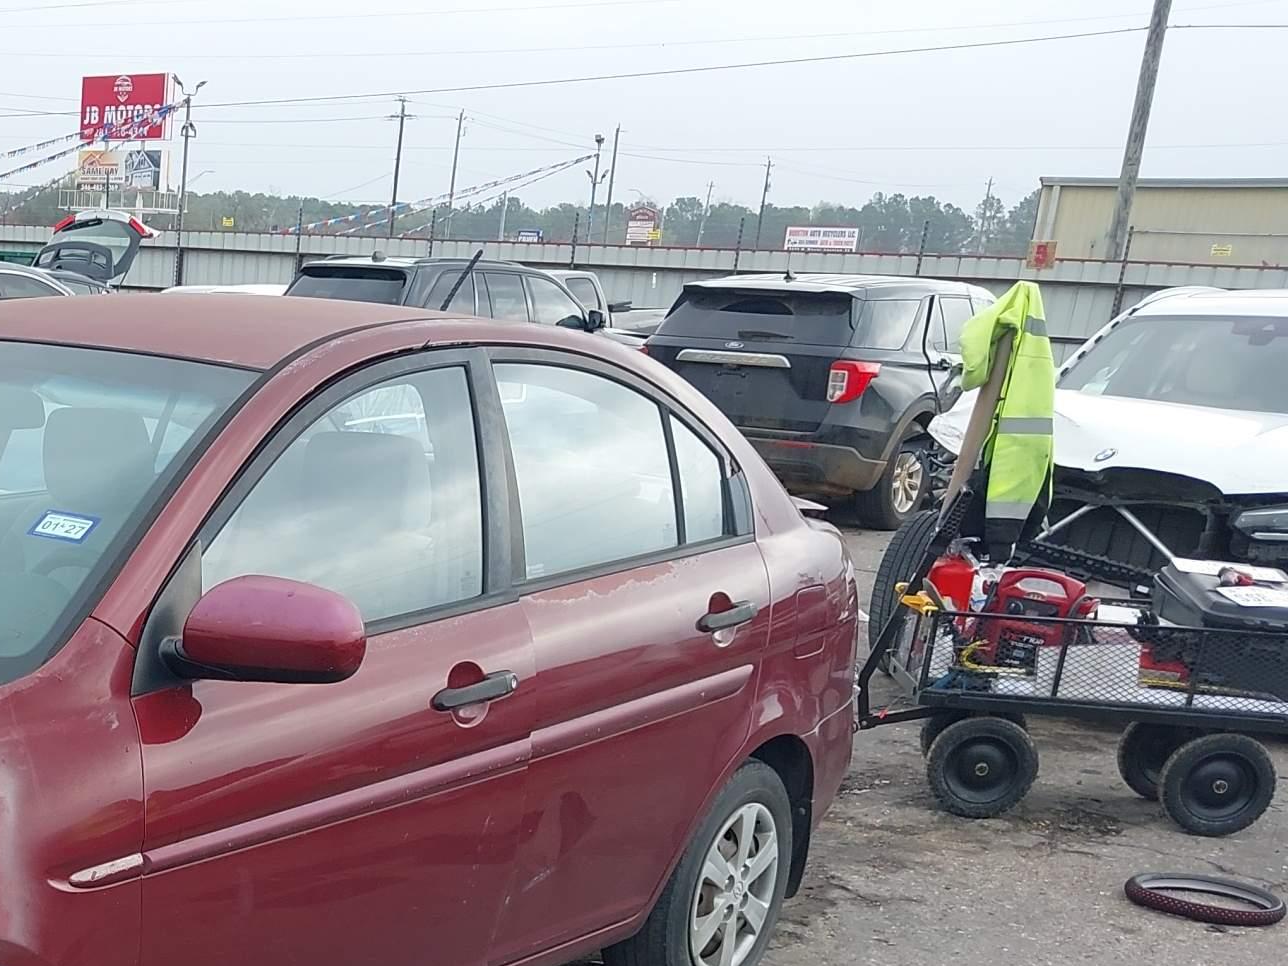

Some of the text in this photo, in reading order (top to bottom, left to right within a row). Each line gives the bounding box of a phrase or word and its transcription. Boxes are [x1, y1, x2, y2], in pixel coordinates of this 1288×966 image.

[84, 106, 99, 124] JB
[80, 167, 101, 175] SAME
[41, 520, 87, 535] 01 27
